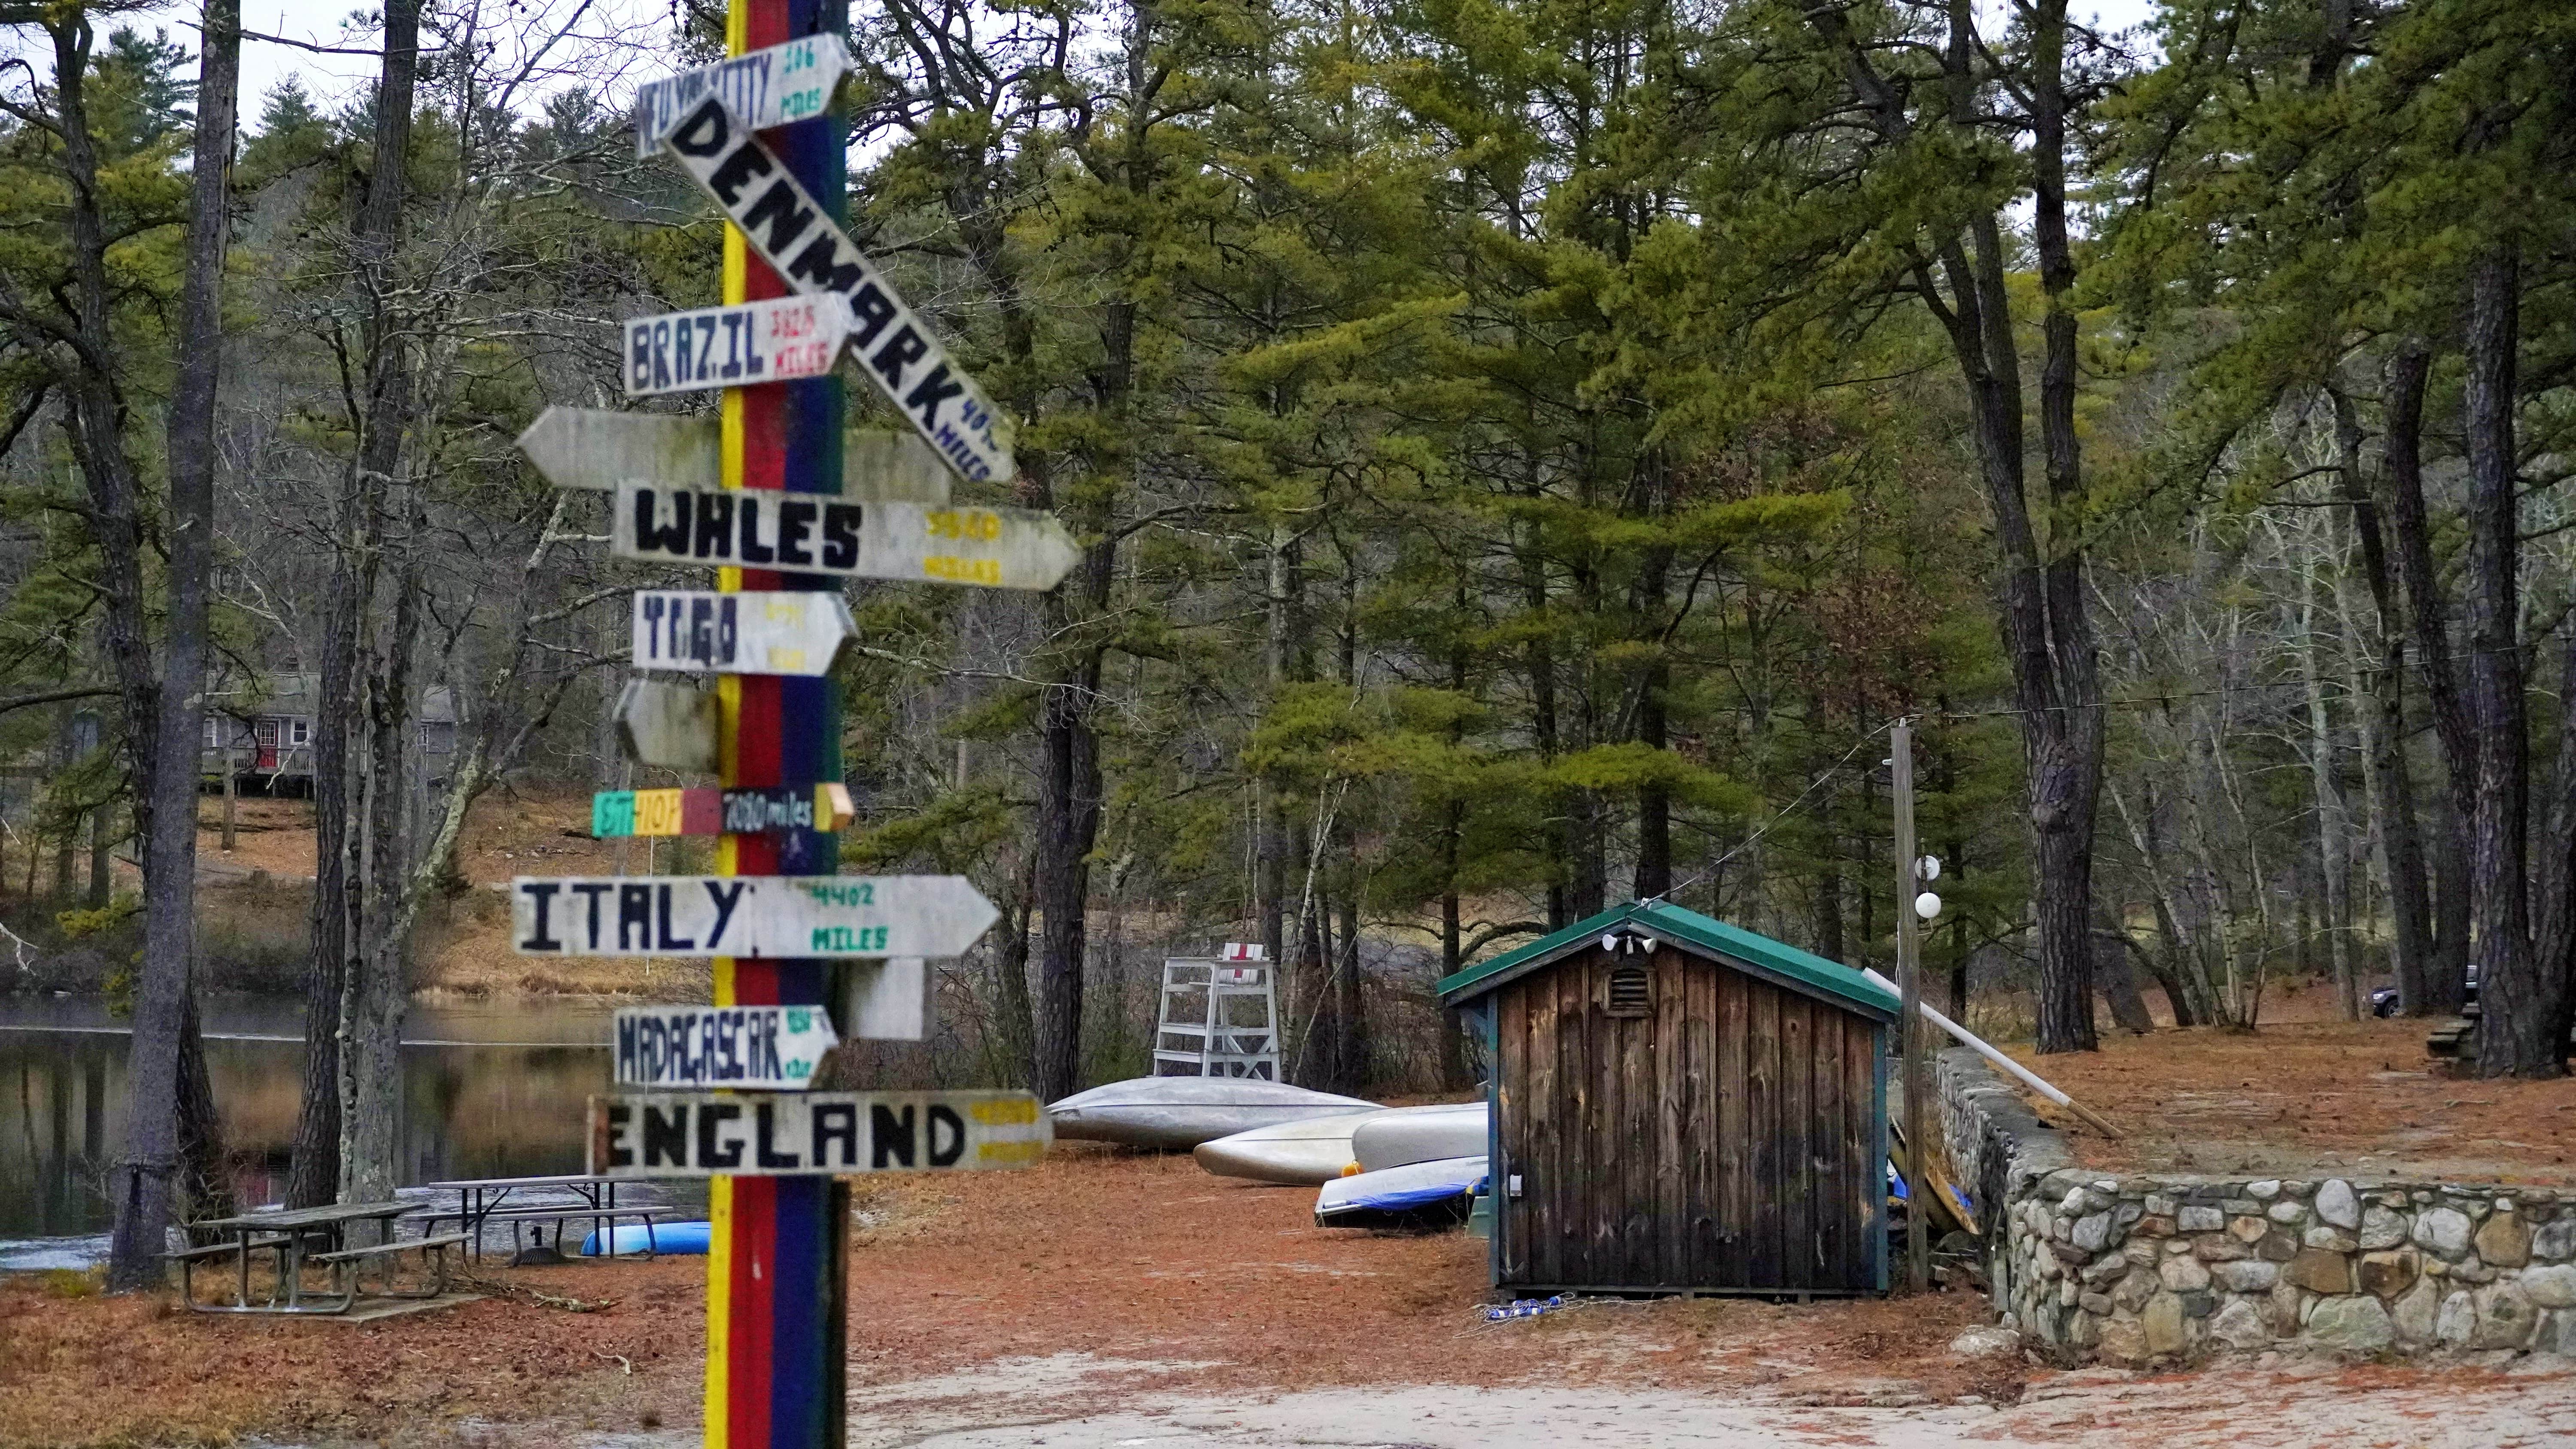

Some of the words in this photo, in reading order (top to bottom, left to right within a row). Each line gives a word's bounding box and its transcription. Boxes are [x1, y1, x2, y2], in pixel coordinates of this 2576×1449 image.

[671, 98, 964, 432] DENMARK
[632, 311, 764, 390] BRAZIL
[936, 421, 991, 482] MILES
[635, 488, 863, 568] WALES
[767, 791, 812, 827] miles
[520, 881, 745, 950] ITALY
[811, 926, 887, 952] MILES
[619, 1010, 783, 1082] MADAGASCAR
[606, 1102, 966, 1169] ENGLAND
